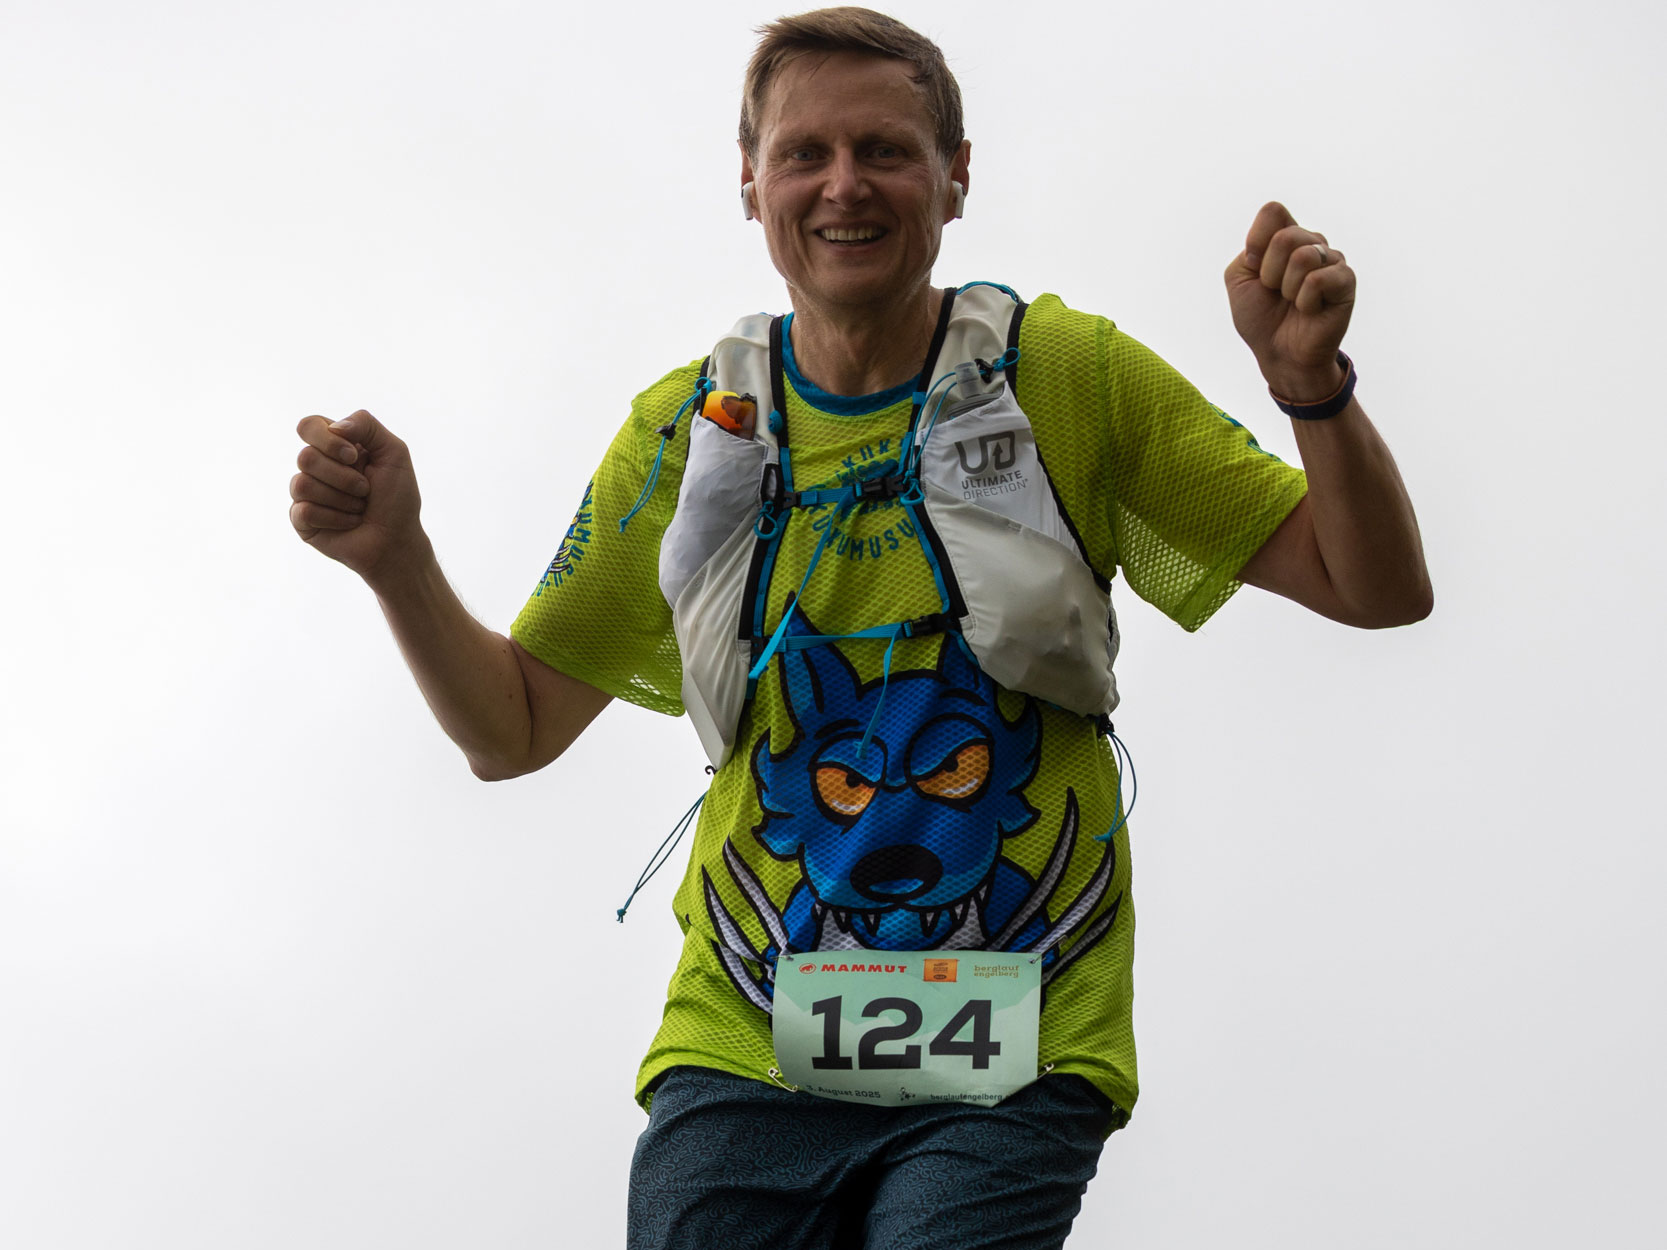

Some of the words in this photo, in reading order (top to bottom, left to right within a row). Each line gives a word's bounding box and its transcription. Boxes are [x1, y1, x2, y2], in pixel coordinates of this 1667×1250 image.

[961, 470, 1023, 490] ULTIMATE
[963, 479, 1027, 500] DIRECTION
[821, 963, 907, 973] MAMMUT
[974, 964, 1019, 973] berglauf
[973, 971, 1019, 979] engelberg
[811, 995, 1001, 1070] 124
[818, 1086, 853, 1097] August
[855, 1089, 881, 1099] 2025
